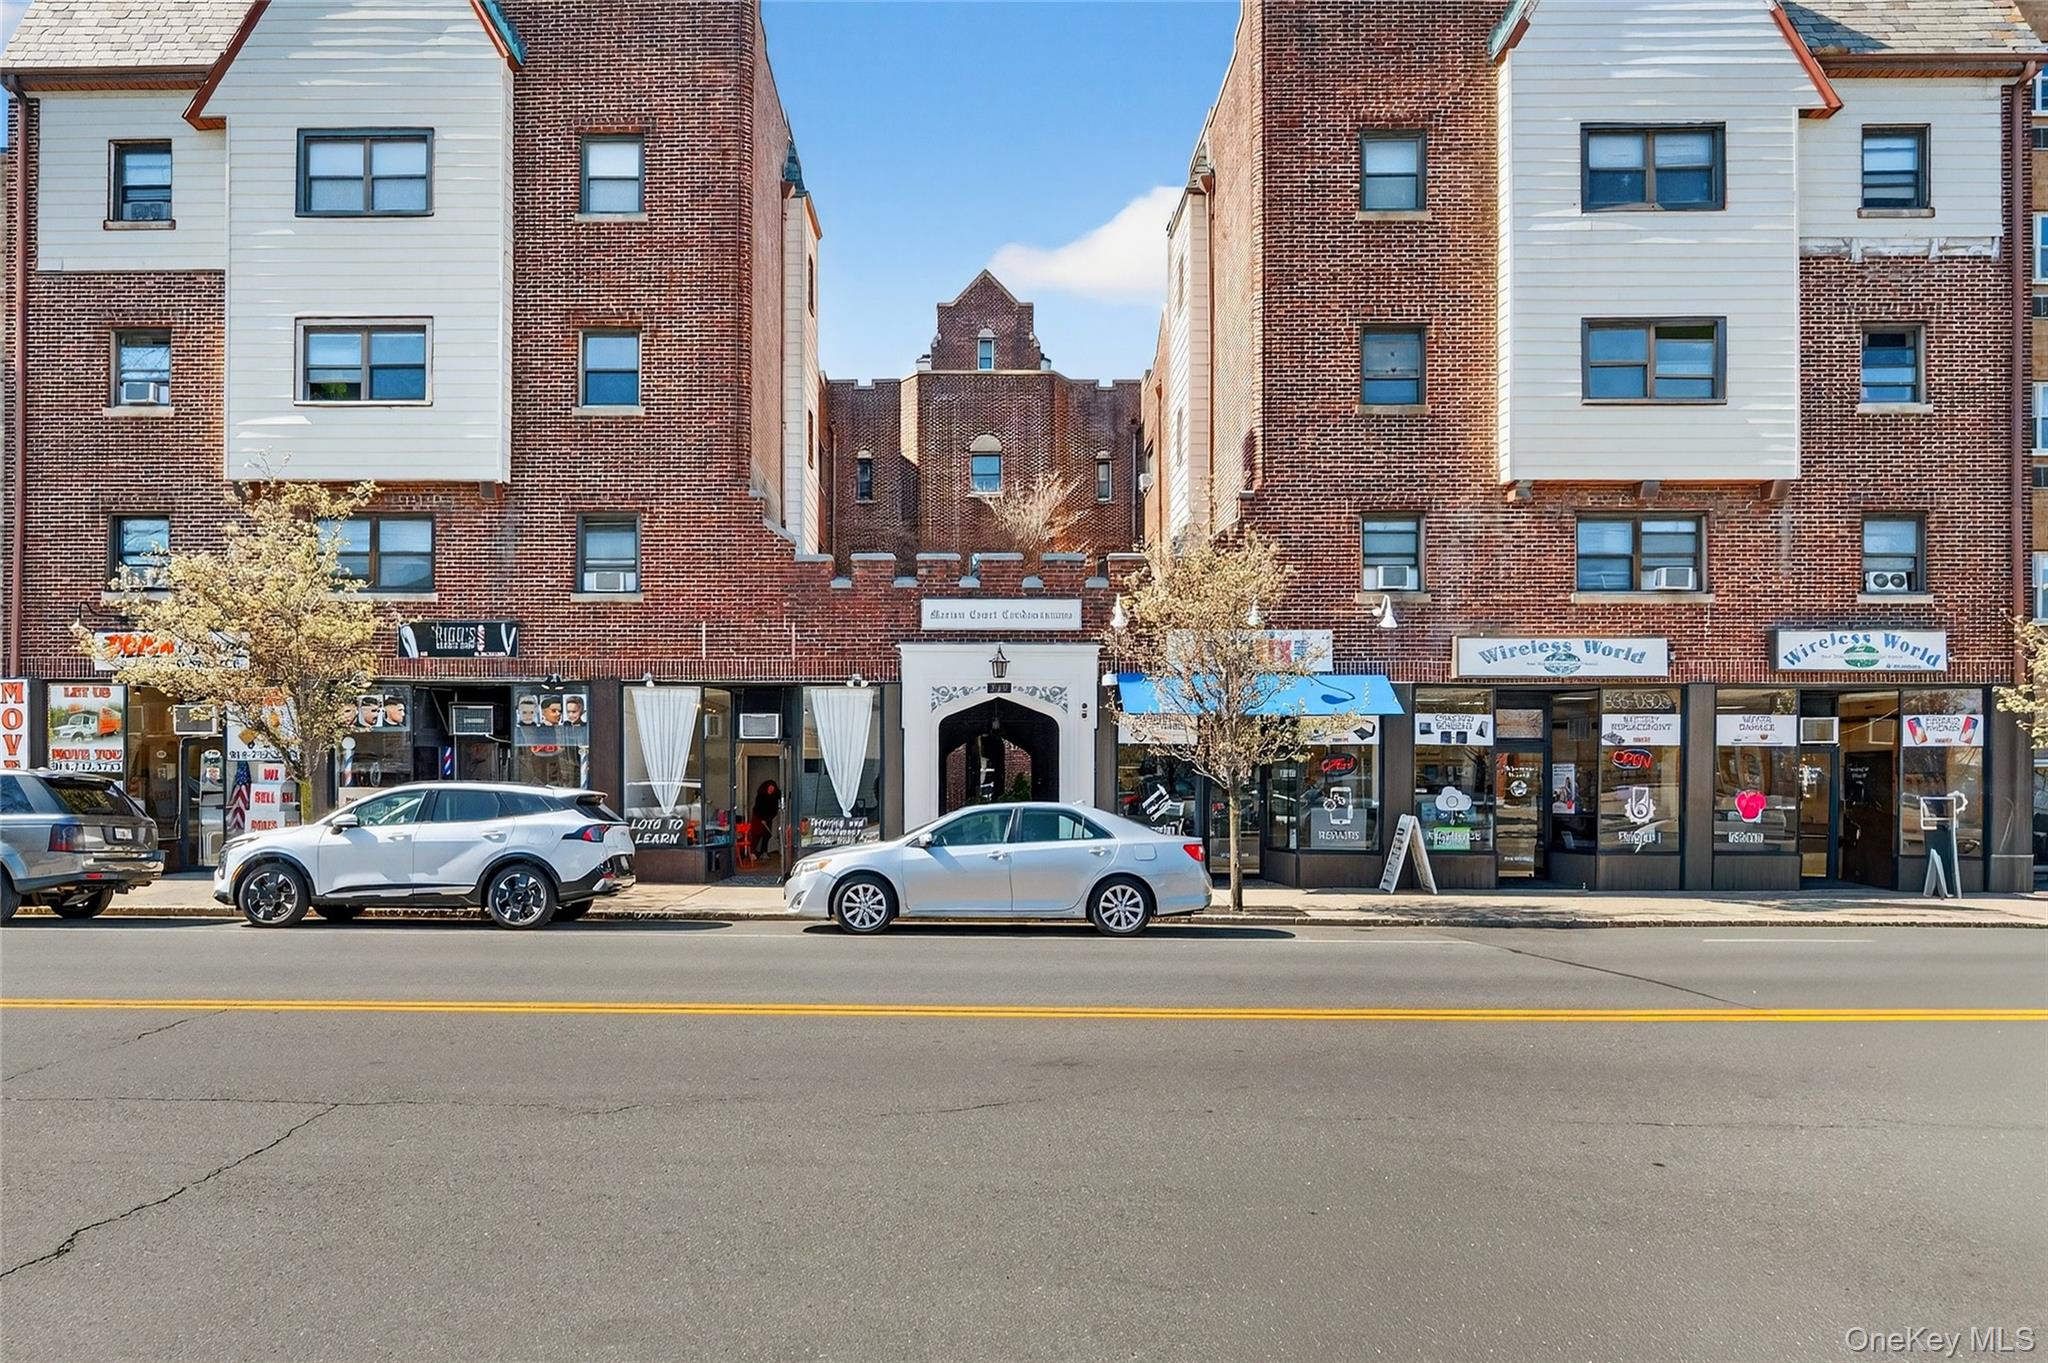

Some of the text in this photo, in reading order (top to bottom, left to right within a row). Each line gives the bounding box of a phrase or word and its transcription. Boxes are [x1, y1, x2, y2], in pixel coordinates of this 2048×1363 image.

[1478, 640, 1647, 665] Wireless World
[1783, 633, 1942, 668] Wireless World
[63, 687, 111, 698] LET US
[51, 749, 122, 760] MOVE YOU
[1613, 751, 1652, 769] OPEN
[255, 791, 275, 803] SELL
[669, 819, 683, 830] TO
[635, 833, 680, 844] LEARN
